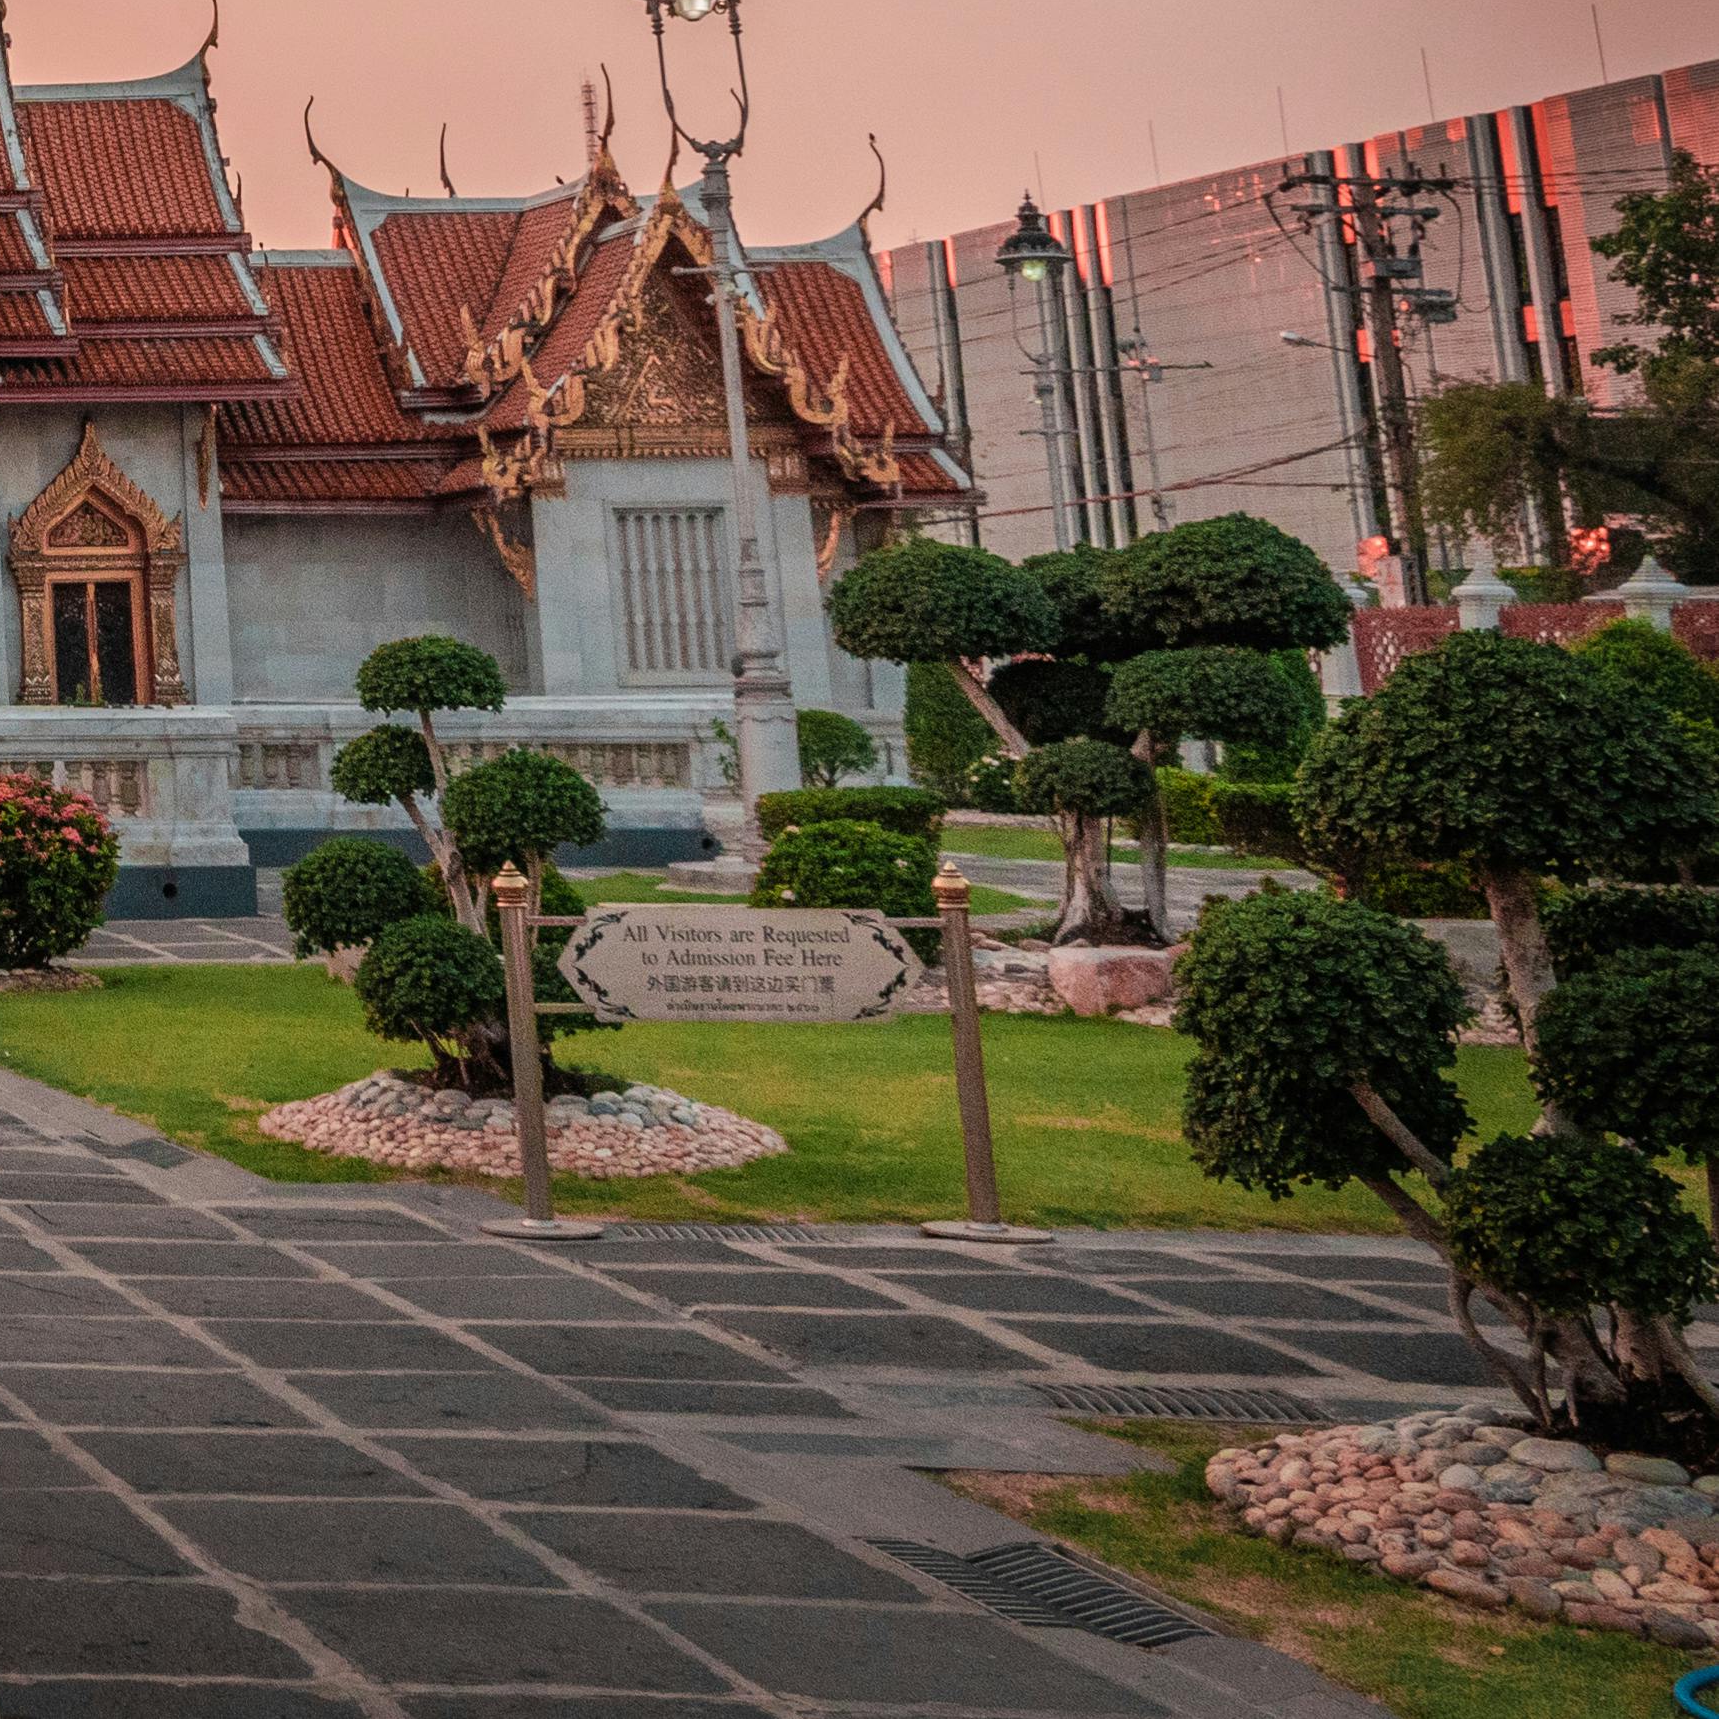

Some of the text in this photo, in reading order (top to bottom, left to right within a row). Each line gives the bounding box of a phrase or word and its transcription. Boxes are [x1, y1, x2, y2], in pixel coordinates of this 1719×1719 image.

[624, 925, 850, 947] All Visitors are Requested
[642, 949, 844, 966] to Admission Fee Here
